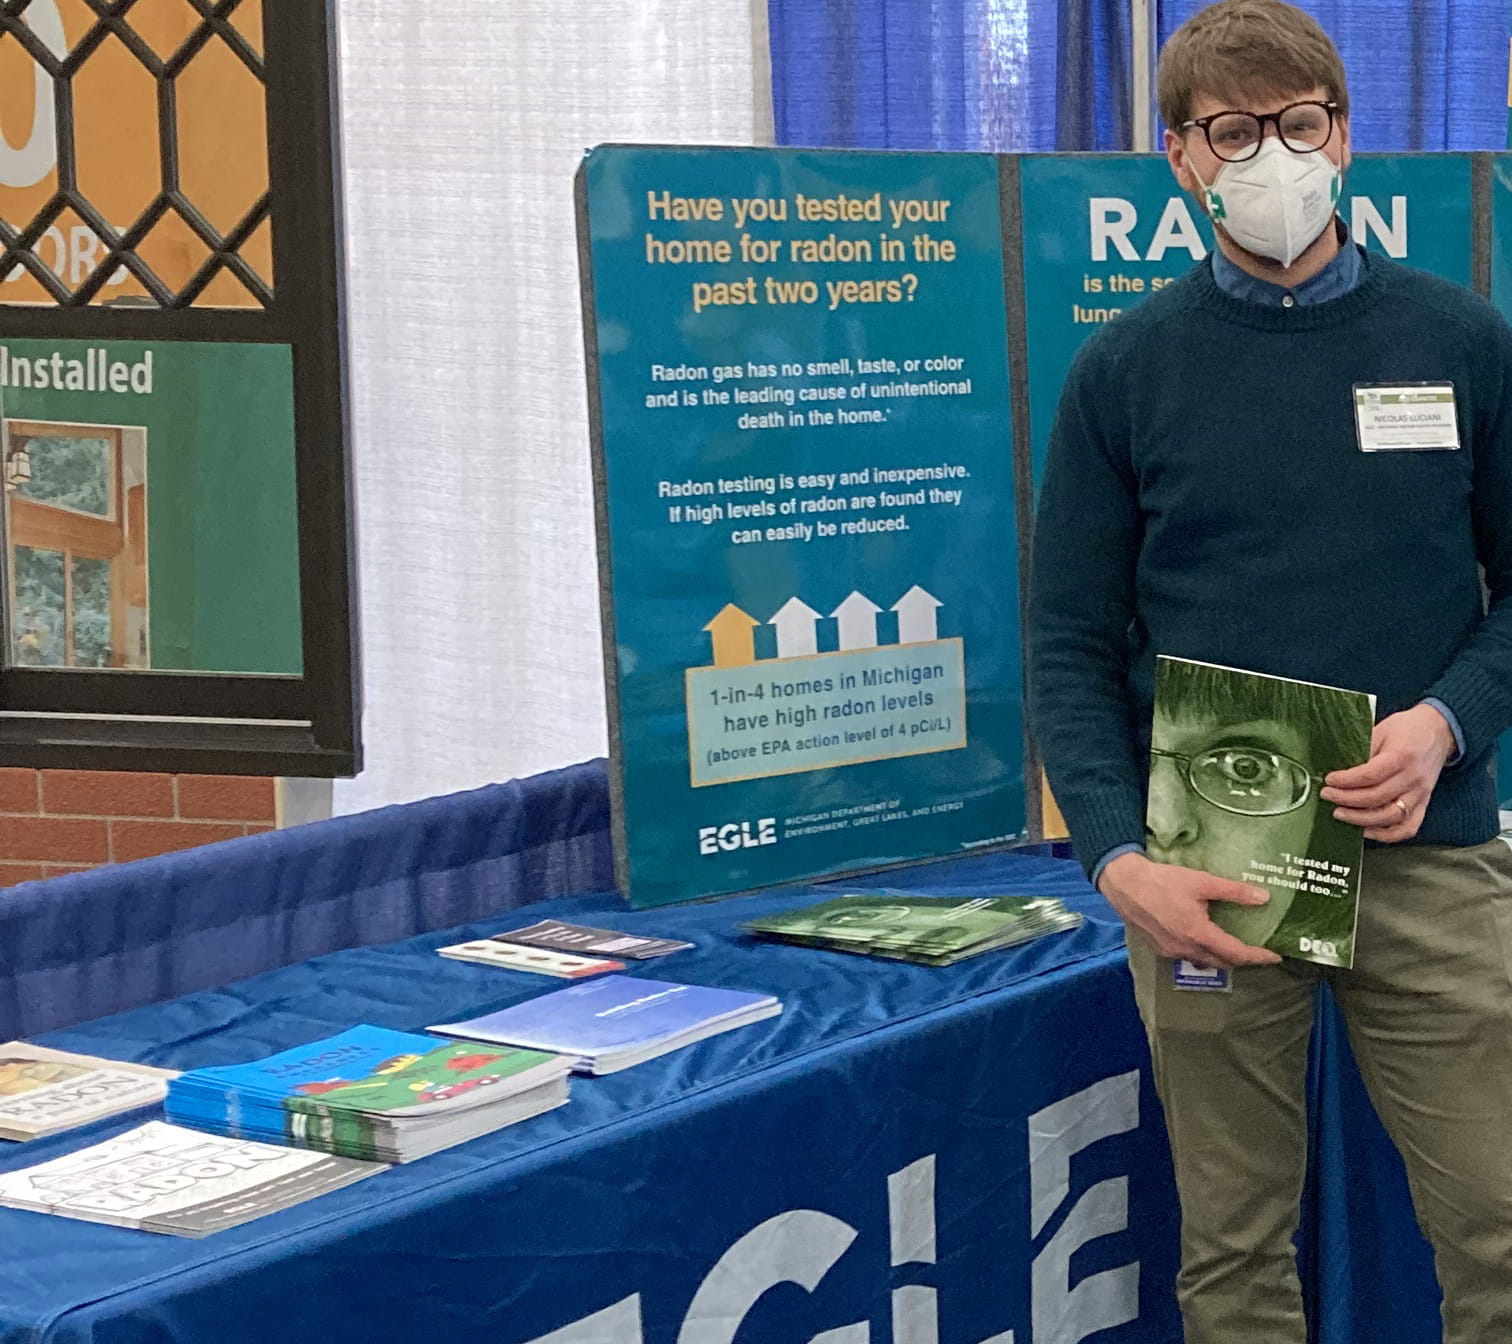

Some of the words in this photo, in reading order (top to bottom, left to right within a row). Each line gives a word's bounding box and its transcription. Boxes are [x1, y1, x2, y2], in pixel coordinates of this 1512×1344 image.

[647, 191, 723, 221] Have
[732, 199, 787, 228] you
[796, 193, 881, 222] tested
[889, 198, 951, 228] your
[1090, 196, 1408, 261] RAN
[645, 234, 731, 263] home
[740, 234, 779, 262] for
[790, 234, 872, 262] radon
[881, 234, 905, 262] in
[913, 234, 956, 261] the
[693, 276, 757, 313] past
[765, 277, 819, 304] two
[827, 274, 919, 310] years?
[1084, 273, 1103, 292] is
[1109, 273, 1145, 292] the
[0, 346, 153, 394] Installed
[652, 363, 708, 382] Radon
[712, 363, 743, 384] gas
[747, 361, 777, 378] has
[782, 362, 803, 377] no
[807, 358, 854, 378] smell,
[858, 358, 900, 376] taste,
[904, 359, 921, 373] or
[924, 356, 964, 372] color
[645, 391, 678, 408] and
[683, 389, 698, 406] is
[703, 388, 730, 406] the
[734, 385, 794, 407] leading
[799, 386, 846, 402] cause
[850, 383, 866, 400] of
[871, 379, 972, 399] unintentional
[738, 412, 784, 431] death
[789, 411, 804, 428] in
[808, 410, 834, 427] the
[1374, 414, 1408, 423] NICOLAS
[658, 479, 714, 499] Radon
[718, 475, 775, 496] testing
[779, 472, 795, 490] is
[798, 472, 835, 491] easy
[839, 468, 869, 486] and
[873, 463, 971, 486] inexpensive.
[669, 506, 682, 523] If
[685, 504, 723, 525] high
[727, 500, 776, 518] levels
[780, 498, 797, 515] of
[800, 495, 848, 513] radon
[851, 494, 876, 509] are
[880, 489, 925, 507] found
[929, 487, 962, 507] they
[731, 529, 762, 545] can
[766, 523, 813, 543] easily
[817, 519, 837, 536] be
[841, 515, 910, 535] reduced.
[710, 687, 764, 706] 1-in-4
[771, 677, 833, 700] homes
[840, 673, 856, 690] in
[863, 662, 944, 692] Michigan
[724, 713, 769, 733] have
[776, 704, 817, 729] high
[823, 699, 875, 720] radon
[882, 690, 934, 712] levels
[706, 744, 757, 766] (above
[762, 739, 792, 756] EPA
[796, 732, 840, 751] action
[844, 726, 877, 744] level
[880, 725, 894, 739] of
[898, 723, 906, 737] 4
[699, 817, 777, 855] EGLE
[1250, 859, 1284, 874] home
[1287, 866, 1305, 878] for
[1294, 856, 1329, 870] tested
[1331, 864, 1351, 876] my
[1241, 872, 1265, 882] you
[1267, 875, 1308, 891] should
[1300, 937, 1338, 958] DEQ
